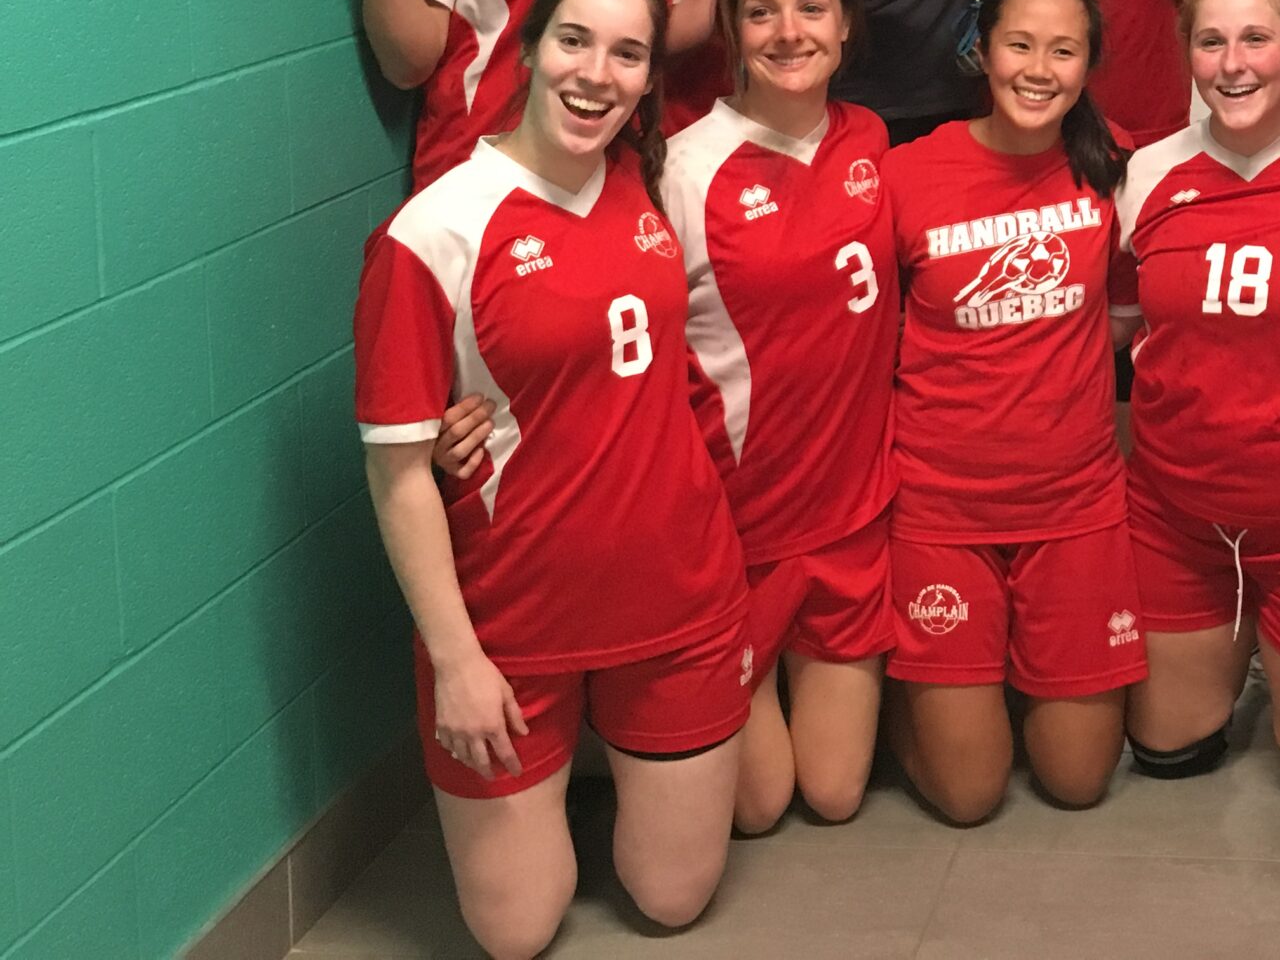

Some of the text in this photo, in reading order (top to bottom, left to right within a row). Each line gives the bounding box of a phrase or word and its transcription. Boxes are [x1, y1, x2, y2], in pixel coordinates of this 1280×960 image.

[745, 201, 779, 221] errea
[926, 197, 1103, 260] HANDBALL
[515, 255, 554, 277] errea
[834, 240, 879, 314] 3
[1201, 242, 1273, 317] 18
[607, 293, 654, 378] 8
[908, 601, 969, 621] CHAMPLAIN
